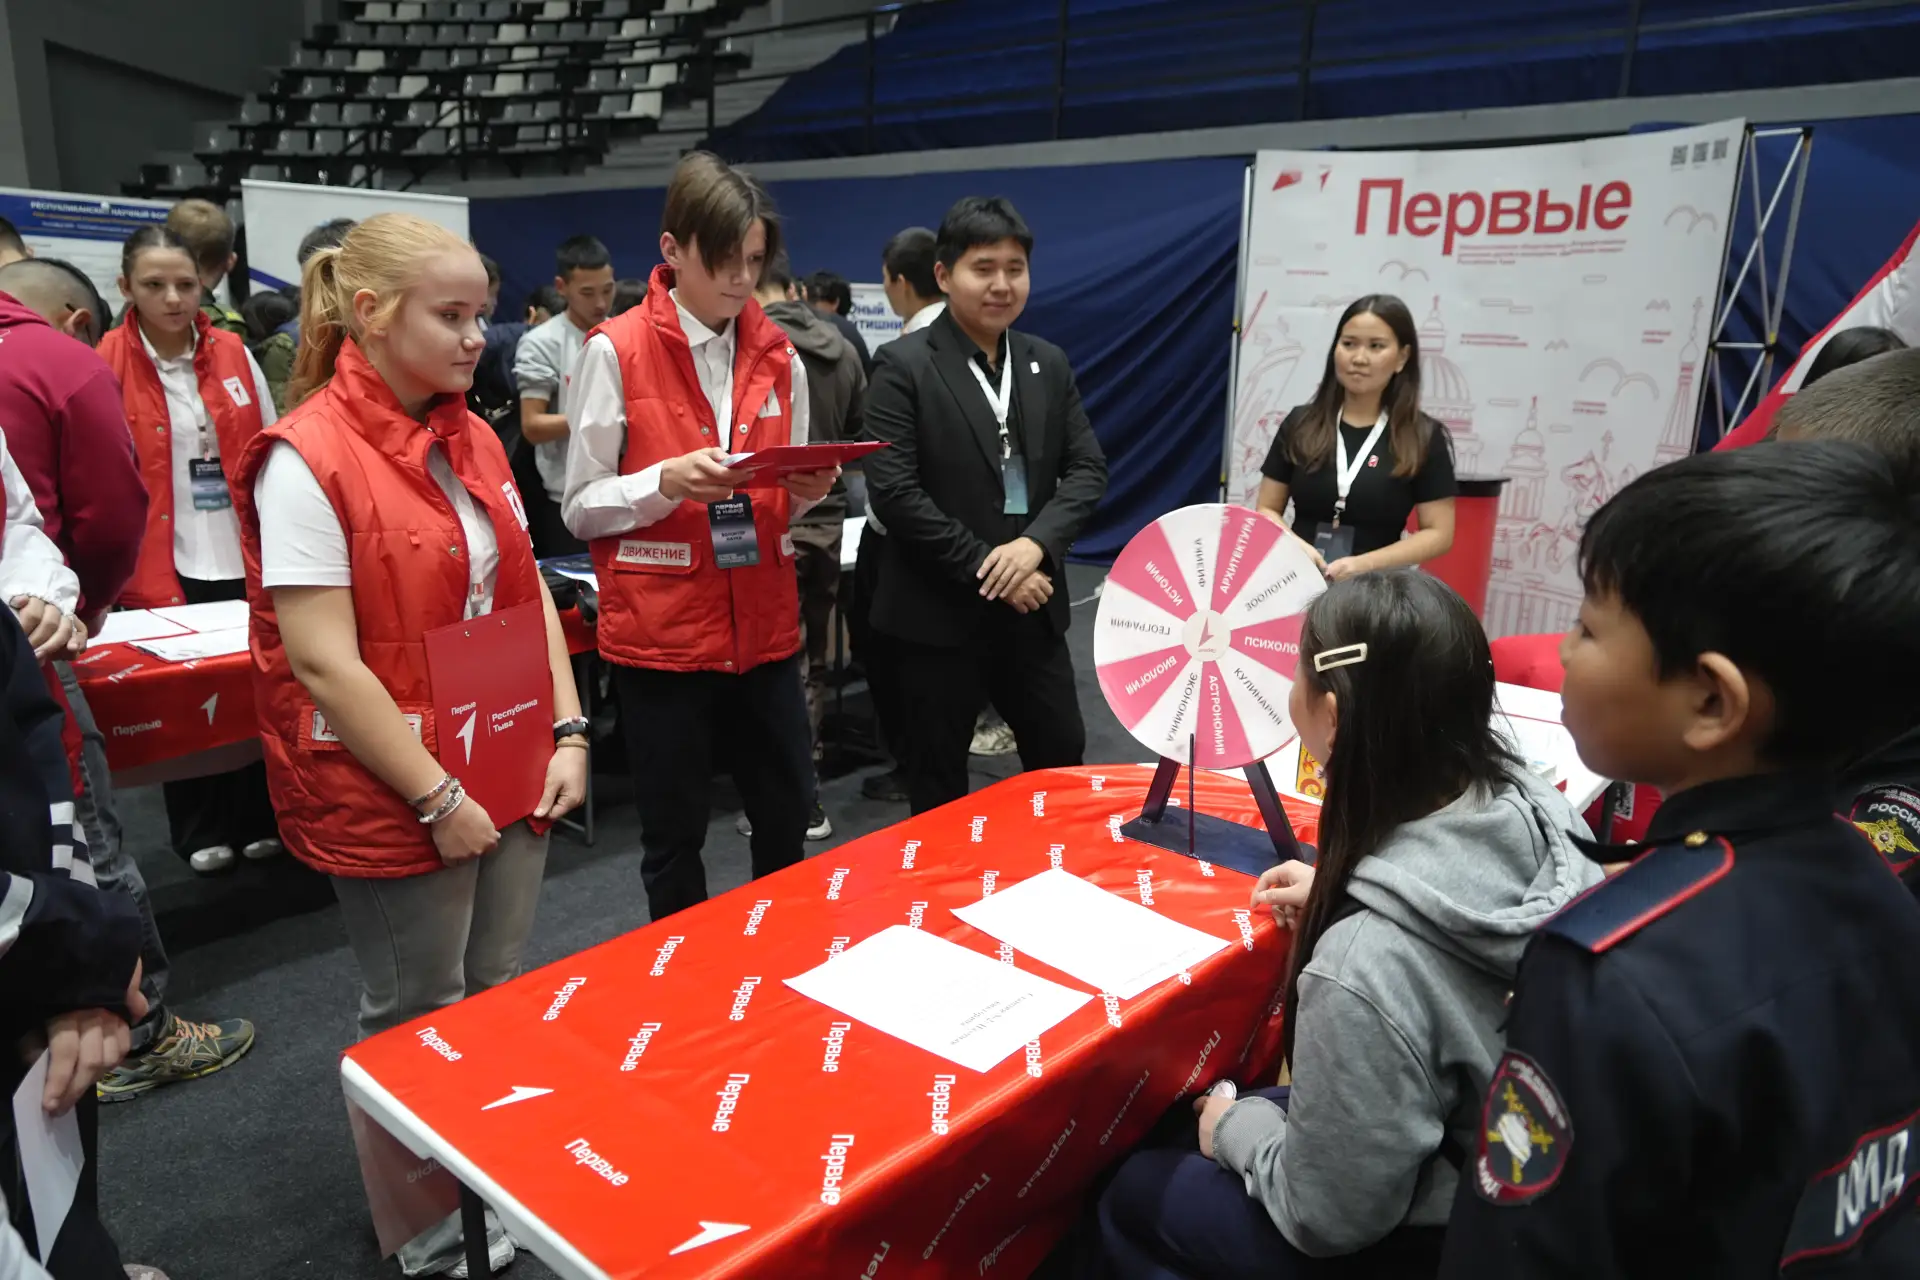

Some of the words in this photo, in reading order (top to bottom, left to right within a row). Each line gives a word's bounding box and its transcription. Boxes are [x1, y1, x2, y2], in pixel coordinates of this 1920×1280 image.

[1355, 178, 1632, 256] Первые
[621, 546, 686, 560] ДВИЖЕНИЕ
[1220, 517, 1257, 594] АРХИТЕКТУРА
[1144, 560, 1184, 606] ИСТОРИЯ
[1246, 571, 1298, 612] ЗООЛОГИЯ
[1110, 617, 1171, 636] ГЕОГРАФИЯ
[1125, 655, 1178, 695] БИОЛОГИЯ
[450, 701, 476, 716] Первые
[491, 699, 538, 722] Республика
[1166, 672, 1199, 743] ЭКОНОМИКА
[1207, 674, 1225, 756] АСТРОНОМИЯ
[1233, 667, 1283, 727] КУЛИНАРИЯ
[112, 719, 162, 737] Первые
[492, 720, 514, 732] Тыва
[1029, 791, 1047, 817] Первые
[967, 816, 987, 842] Первые
[900, 840, 922, 869] Первые
[827, 868, 850, 900] Первые
[978, 870, 999, 898] Первы
[1134, 869, 1155, 906] Первые
[743, 900, 773, 936] Первые
[905, 901, 929, 930] Перв
[1231, 908, 1255, 951] Первые
[649, 936, 685, 977] Первые
[542, 976, 587, 1021] Первые
[729, 976, 762, 1022] Первые
[1097, 991, 1122, 1028] рвые
[416, 1026, 462, 1062] Первые
[619, 1022, 662, 1072] Первые
[822, 1021, 851, 1073] Первые
[711, 1073, 750, 1132] Первые
[926, 1074, 956, 1136] Первые
[564, 1137, 629, 1186] Первые
[820, 1134, 855, 1206] Первые
[1016, 1118, 1077, 1199] Первые
[1834, 1129, 1909, 1237] ЮИД
